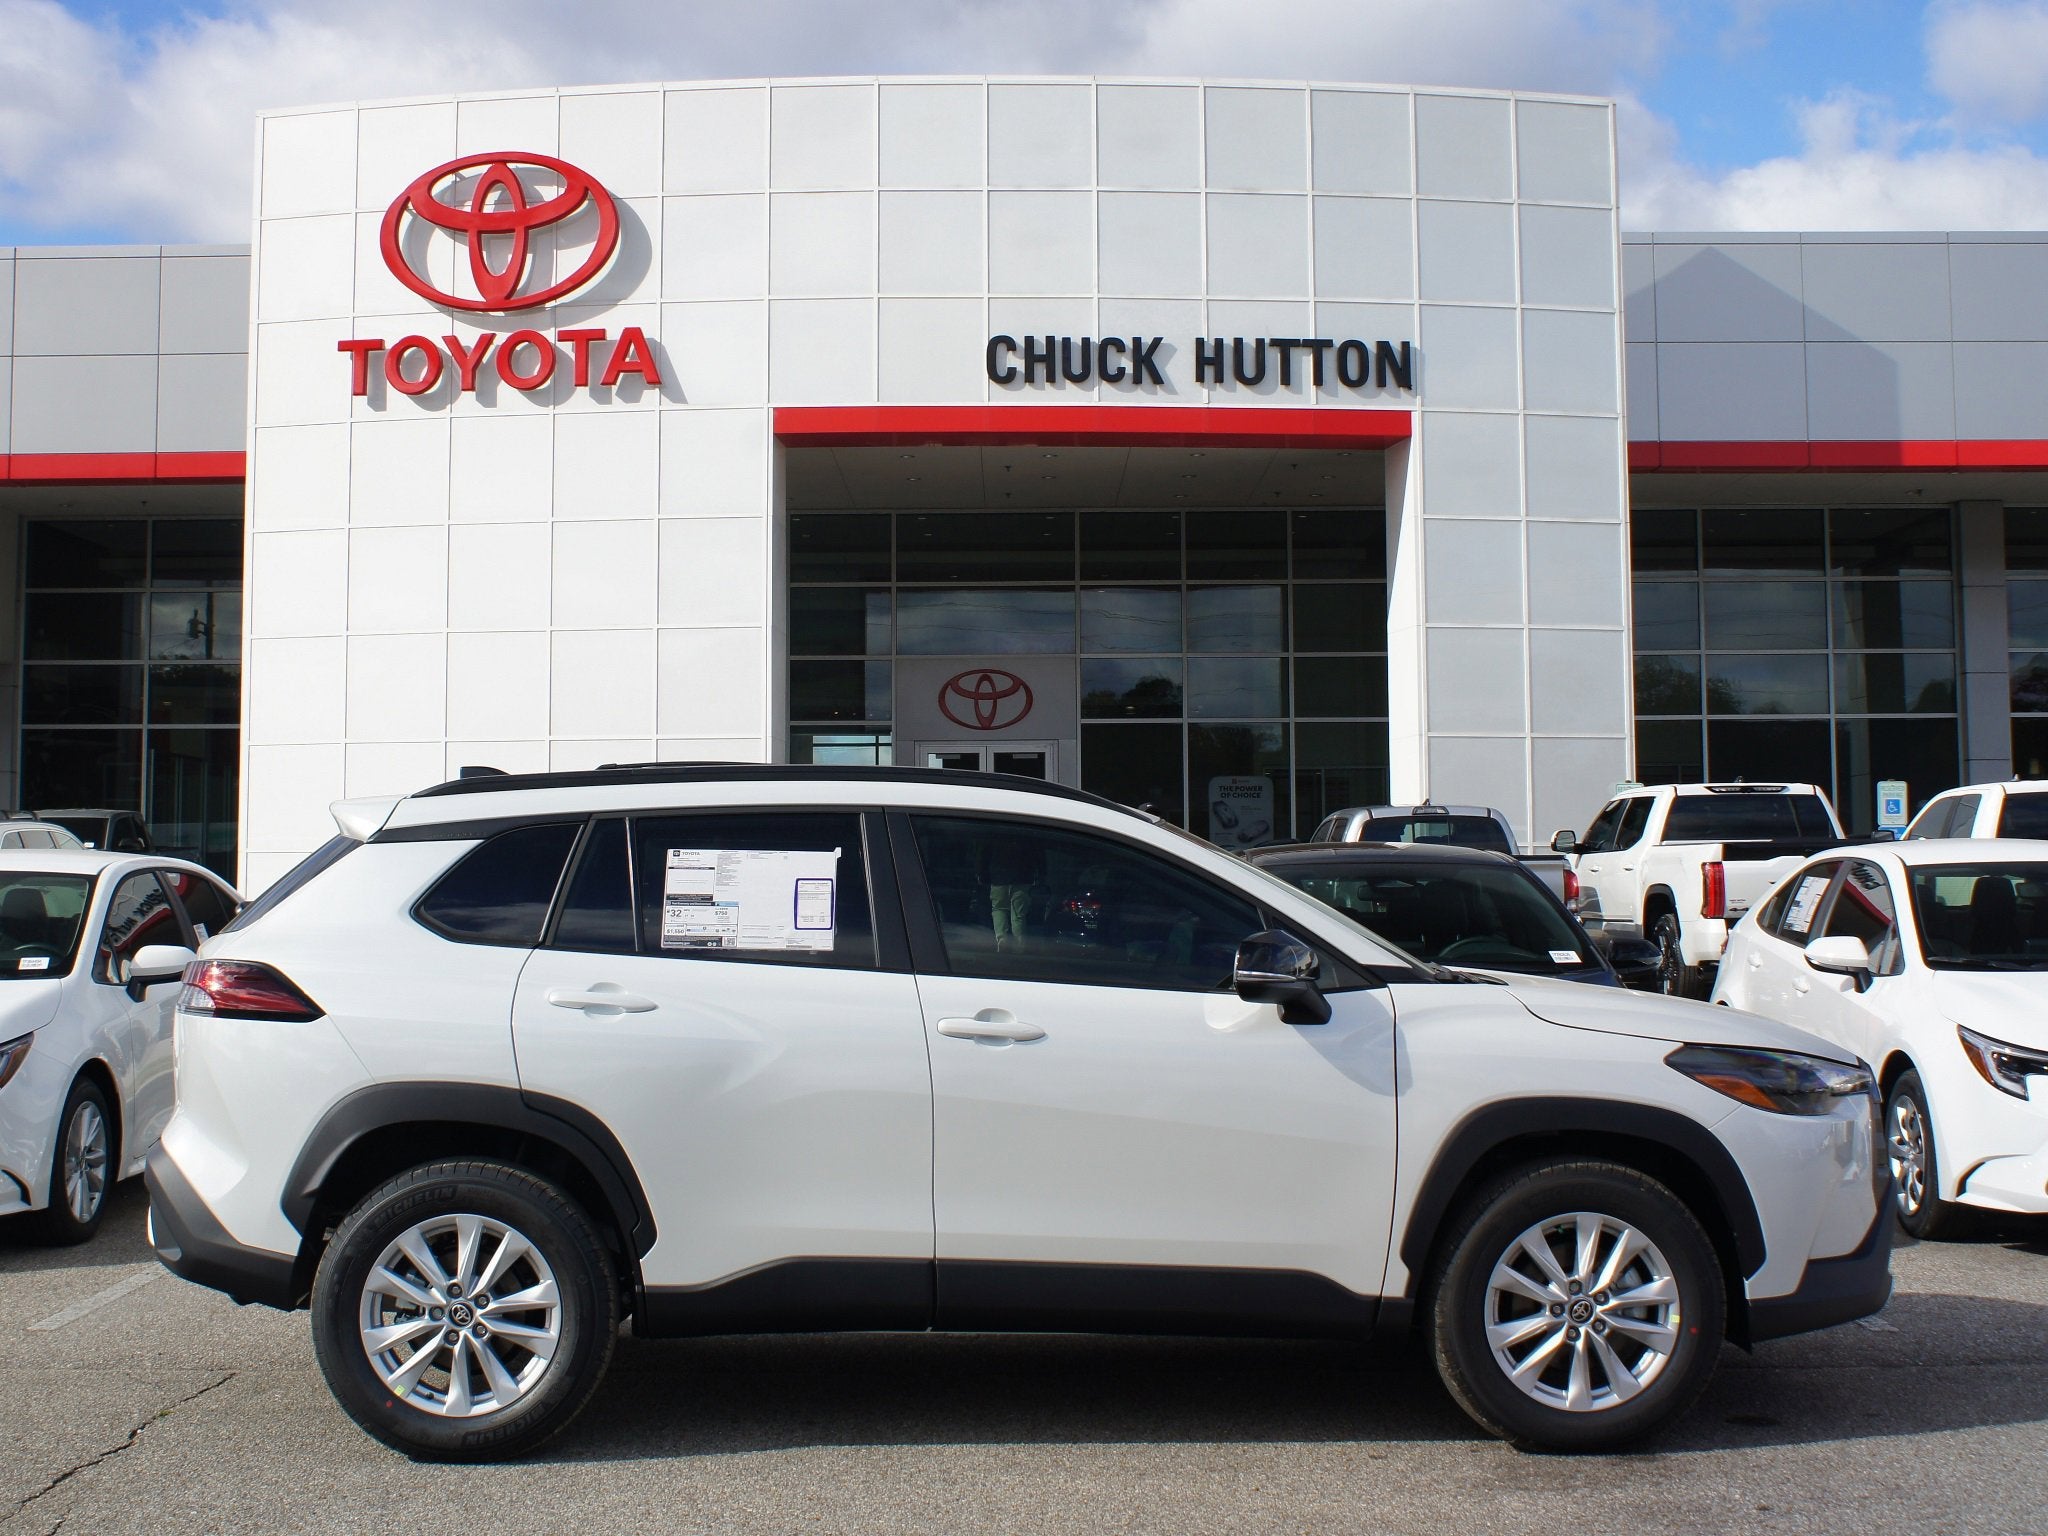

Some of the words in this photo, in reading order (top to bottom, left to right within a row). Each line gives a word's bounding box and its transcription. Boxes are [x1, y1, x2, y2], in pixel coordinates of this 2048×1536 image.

[338, 327, 662, 396] TOYOTA
[986, 335, 1165, 385] CHUCK
[1195, 337, 1413, 389] HUTTON
[670, 909, 682, 918] 32
[373, 1184, 457, 1224] MICHELIN
